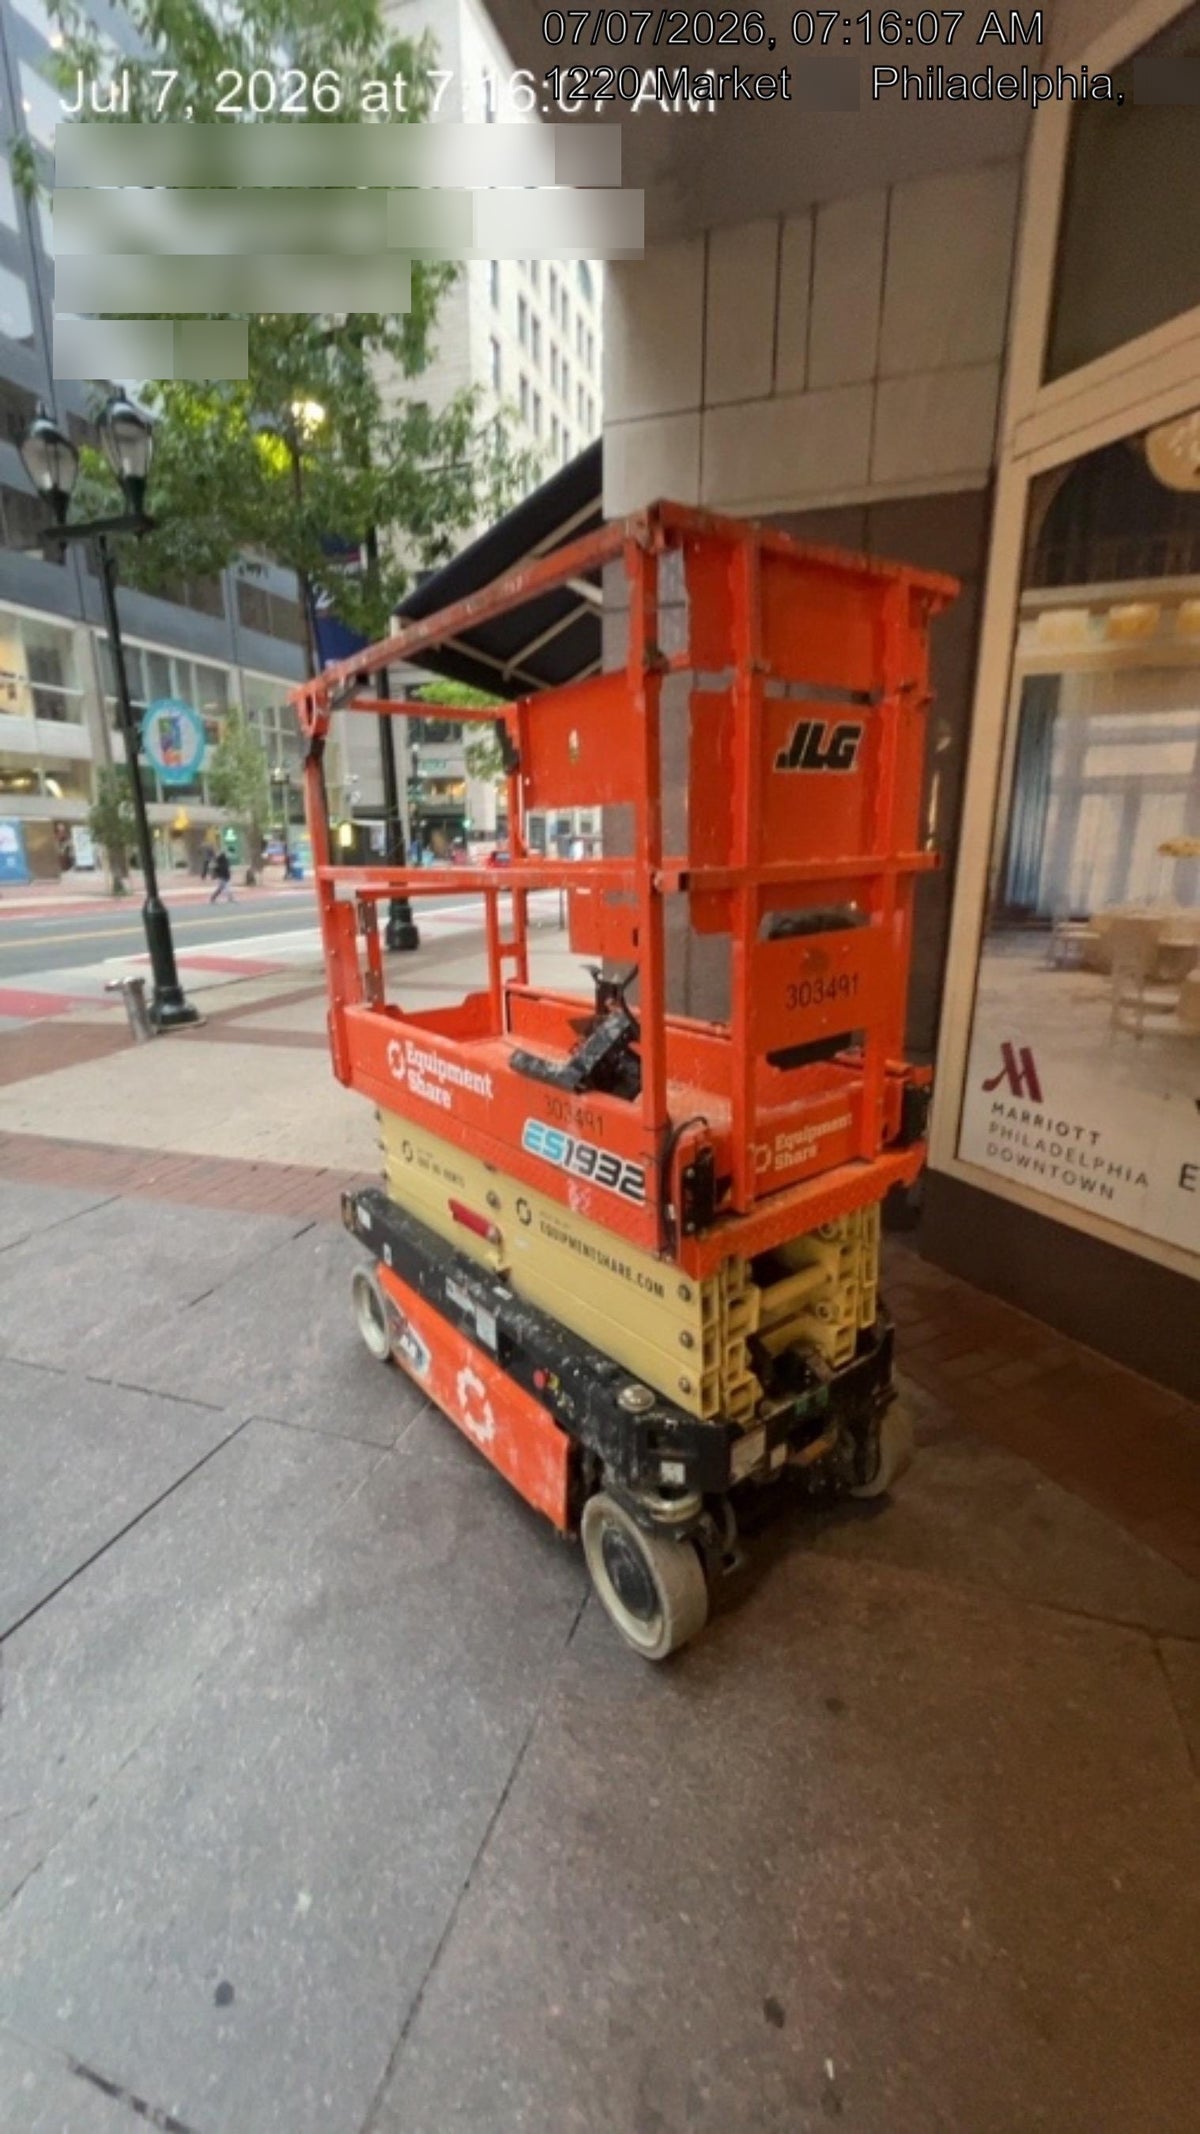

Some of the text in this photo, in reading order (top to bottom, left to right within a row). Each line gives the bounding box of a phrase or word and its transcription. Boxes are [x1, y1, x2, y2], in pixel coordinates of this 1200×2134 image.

[774, 719, 863, 772] JLG
[785, 972, 859, 1012] 303491
[405, 1040, 493, 1099] Equipment
[407, 1068, 451, 1110] Share
[991, 1102, 1101, 1146] MARRIOTT
[522, 1118, 646, 1204] ES1932
[986, 1142, 1114, 1200] DOWNTOWN
[989, 1121, 1149, 1188] PHILADELPHIA
